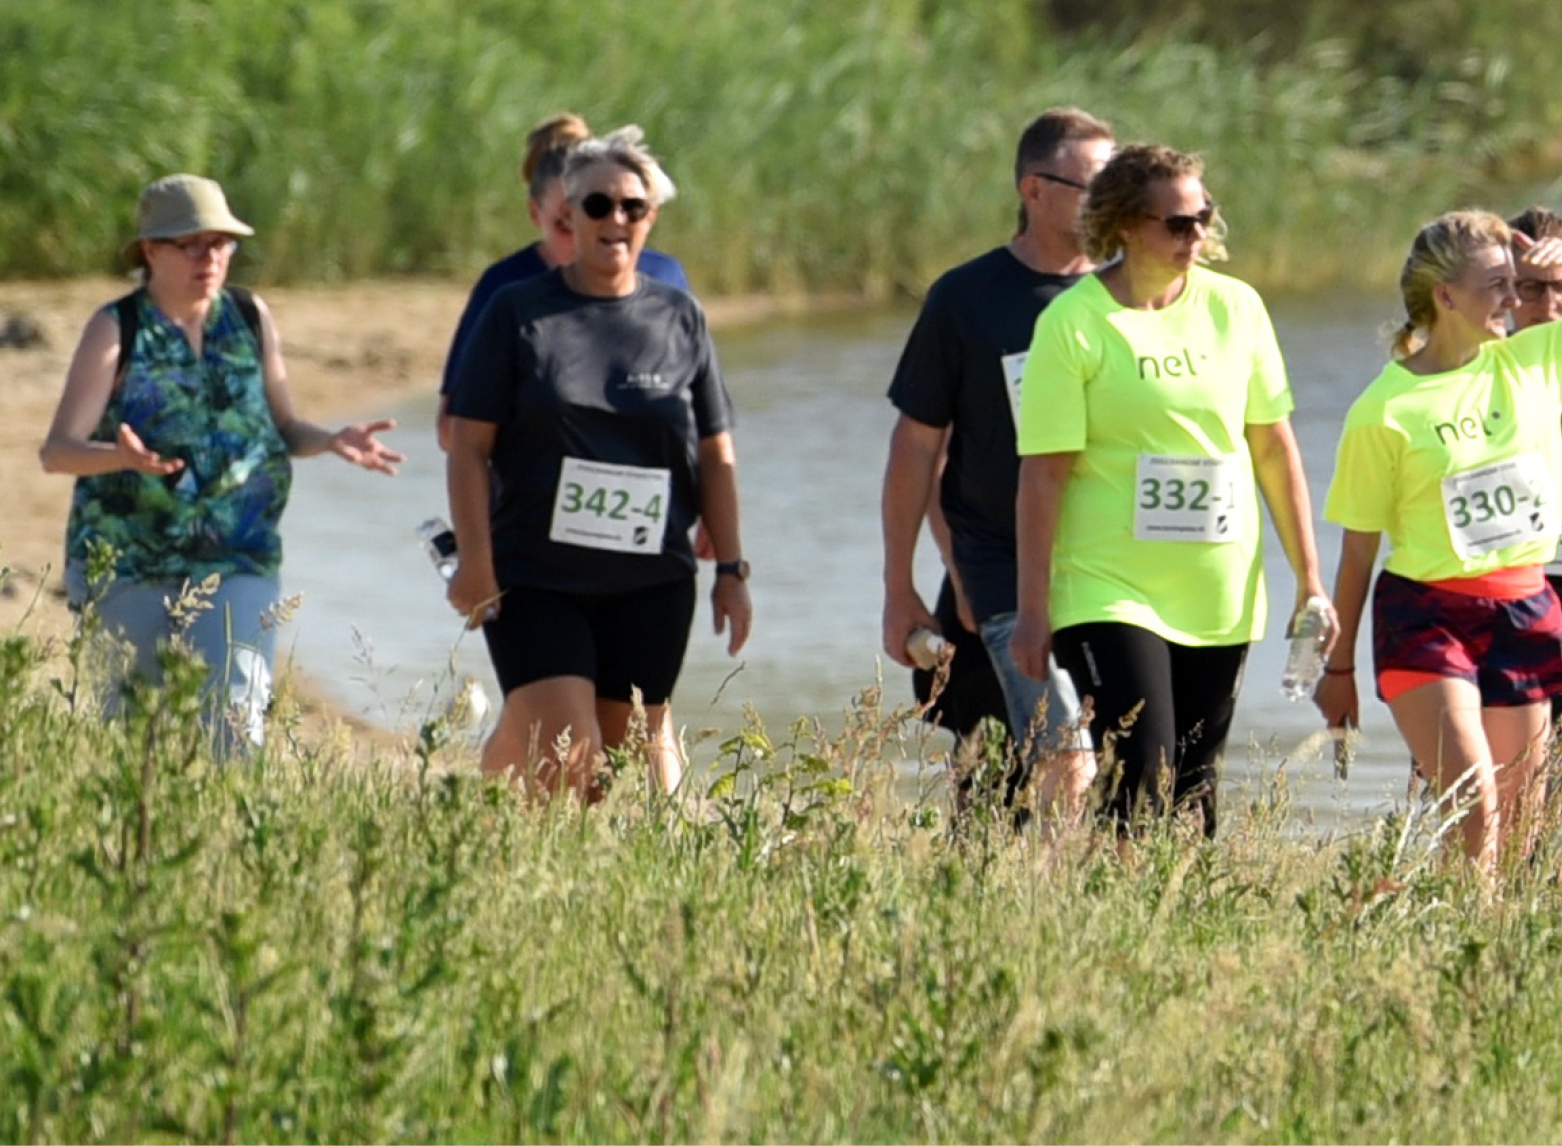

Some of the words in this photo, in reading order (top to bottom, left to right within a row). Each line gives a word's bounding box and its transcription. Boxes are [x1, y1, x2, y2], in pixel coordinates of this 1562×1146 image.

[1138, 348, 1196, 380] nel
[1434, 408, 1492, 445] nel
[561, 482, 662, 524] 342-4
[1140, 477, 1235, 511] 332-1
